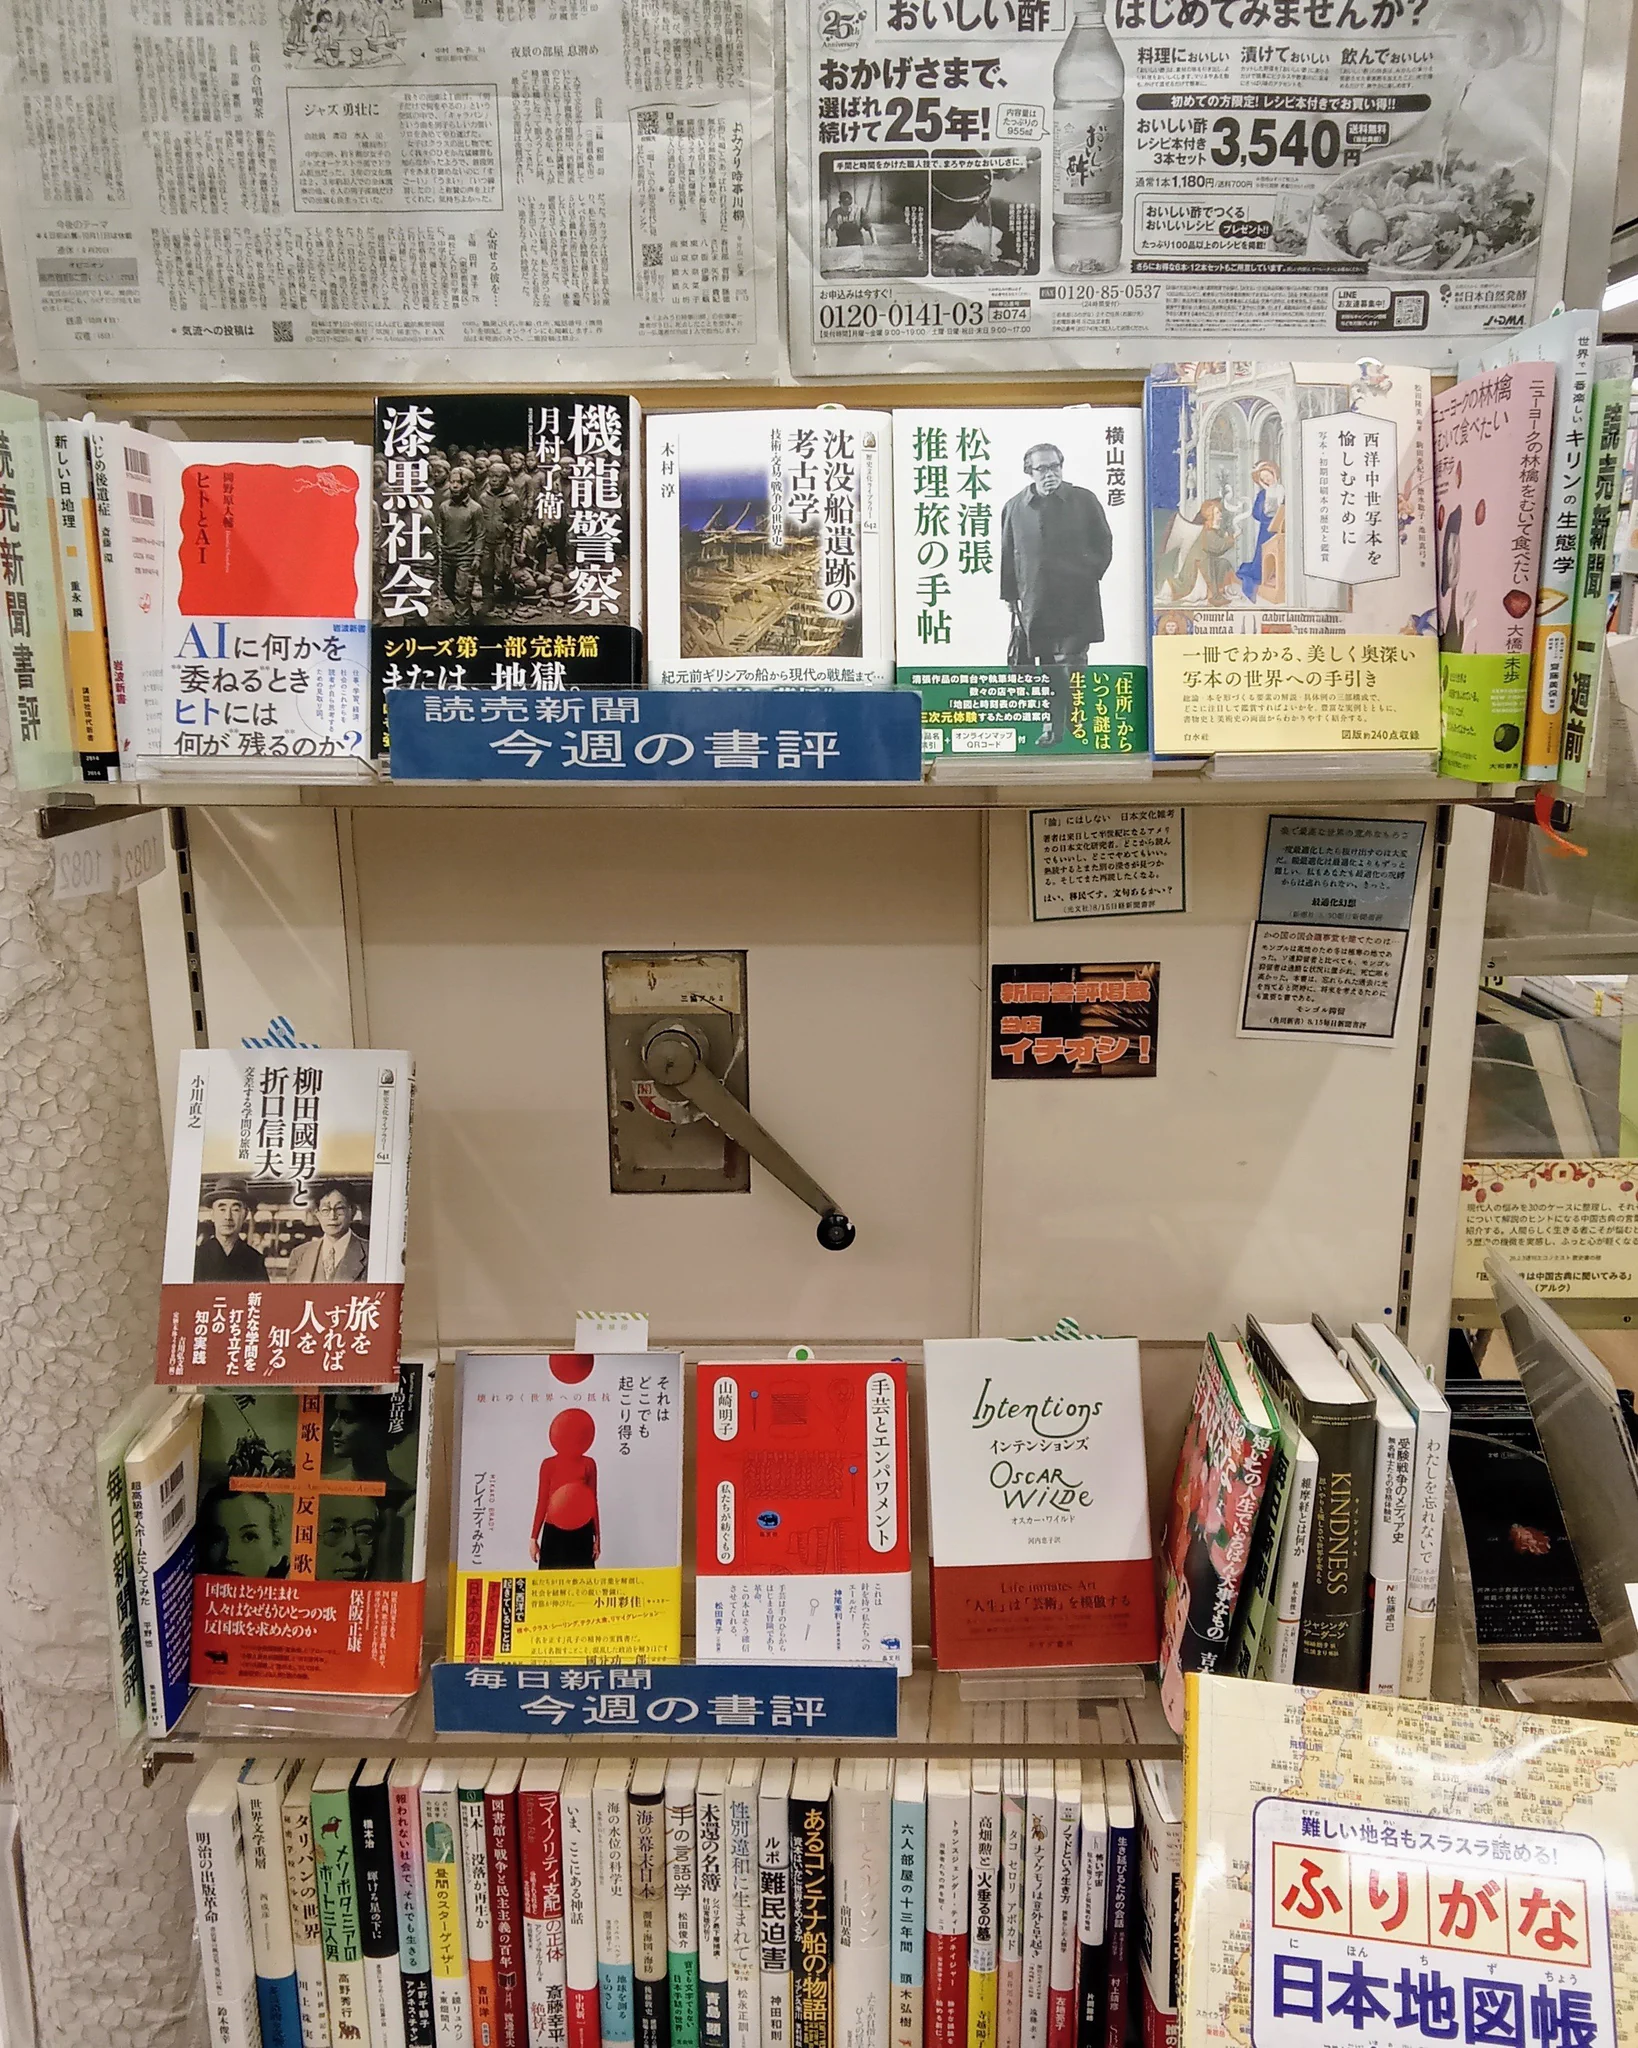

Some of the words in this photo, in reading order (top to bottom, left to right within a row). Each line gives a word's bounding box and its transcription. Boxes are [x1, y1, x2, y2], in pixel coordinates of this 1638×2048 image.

[887, 0, 1050, 33] おいしい酢
[1115, 0, 1428, 30] はじめてみませんか？
[821, 40, 860, 50] Anniversary
[818, 57, 1008, 91] おかげさまで、
[304, 104, 339, 117] ジャズ
[342, 103, 380, 116] 勇壮に
[818, 96, 883, 119] 選ばれ
[1002, 117, 1039, 128] たっぷりの
[1005, 108, 1037, 119] 内容量は
[1136, 118, 1208, 134] おいしい酢
[818, 121, 882, 144] 続けて
[1136, 138, 1207, 151] レシピ本付き
[731, 122, 745, 222] よみうり時事川柳
[1146, 205, 1246, 219] おいしい酢でつくる
[1146, 220, 1215, 232] おいしいレシピ
[819, 288, 894, 300] お申込みは今すぐ！
[1057, 284, 1162, 300] 0120-85-0537
[1338, 291, 1357, 299] LINE
[1464, 290, 1528, 302] 日本自然発酵
[182, 325, 255, 336] 気流への投稿は
[819, 302, 984, 329] 0120-0141-03
[992, 309, 1027, 321] お074
[535, 407, 566, 521] 月村了衛
[787, 428, 821, 525] 考古学
[1105, 426, 1127, 507] 横山茂彦
[1510, 379, 1546, 585] ニューヨークの林檎をむいて食べたい
[770, 427, 783, 548] 技術・交易・戦争の世界史
[956, 427, 993, 576] 松本清張
[1317, 431, 1330, 563] 写本・初期印刷本の歴史と鑑賞
[1337, 430, 1357, 546] 愉しむために
[1363, 431, 1384, 566] 西洋中世写本を
[196, 472, 211, 565] ヒトとAI
[381, 404, 437, 618] 漆黒社会
[567, 403, 623, 618] 機龍警察
[823, 428, 857, 617] 沈没船遺跡の
[912, 426, 953, 645] 推理旅の手帖
[174, 622, 347, 662] AIに何かを
[332, 623, 367, 633] 岩波新書
[383, 634, 601, 660] シリーズ第一部完結篇
[1182, 644, 1417, 665] 一冊でわかる、美しく奥深い
[113, 659, 127, 705] 岩波新書
[180, 665, 312, 695] 委ねるとき
[381, 661, 581, 693] または、地獄。
[661, 667, 885, 685] 紀元前ギリシアの船から現代の戦艦まで…
[969, 685, 1056, 698] 数々の店や宿、風景。
[1182, 669, 1378, 689] 写本の世界への手引き
[175, 698, 278, 726] ヒトには
[422, 695, 640, 724] 読売新聞
[946, 698, 1052, 710] 「地図と時刻表の作家」を
[1069, 671, 1089, 746] 生まれる。
[1092, 671, 1112, 750] いつも謎は
[1114, 670, 1134, 753] 「住所」から
[173, 730, 363, 757] 何が残るのか？
[489, 728, 841, 770] 今週の書評
[955, 732, 1014, 741] オンラインマップ
[966, 740, 1002, 750] QRコード
[1183, 733, 1209, 742] 白水社
[1341, 729, 1420, 741] 図版約240点収録
[1311, 897, 1358, 908] 最適化幻想
[1000, 981, 1151, 1004] 新聞書評掲載
[1296, 1005, 1346, 1016] モンゴル抑留
[1000, 1015, 1043, 1035] 当店
[1000, 1035, 1151, 1065] イチオシ！
[187, 1073, 205, 1129] 小川直之
[254, 1066, 290, 1179] 折口信夫
[288, 1066, 324, 1207] 柳田國男と
[1534, 1284, 1571, 1293] （アルク）
[211, 1297, 228, 1335] 二人の
[243, 1291, 263, 1372] 新たな学問を
[291, 1300, 326, 1355] 人を
[191, 1310, 210, 1365] 知の実践
[225, 1308, 245, 1376] 打ち立てた
[476, 1392, 612, 1404] 壊れゆく世界への抵抗
[618, 1375, 634, 1456] 起こり得る
[638, 1375, 651, 1439] どこでも
[657, 1376, 671, 1422] それは
[972, 1378, 1104, 1438] Intentions
[870, 1377, 891, 1547] 手芸とエンパワメント
[989, 1438, 1091, 1454] インテンションズ
[1391, 1438, 1411, 1544] 受験戦争のメディア史
[1419, 1439, 1441, 1565] わたしを忘れないで
[471, 1472, 488, 1566] ブレイディみかこ
[720, 1483, 732, 1561] 私たちが紡ぐもの
[1011, 1514, 1076, 1525] オスカー・ワイルド
[1326, 1472, 1352, 1595] KINDNESS
[1027, 1536, 1062, 1545] 河内恵子訳
[205, 1582, 300, 1601] 国歌はどう生まれ
[515, 1577, 526, 1622] 今、西洋で
[593, 1596, 642, 1609] 小川彩佳
[874, 1583, 883, 1607] これは
[1001, 1582, 1025, 1594] Life
[1078, 1580, 1097, 1591] Art
[204, 1619, 318, 1639] 反国歌を求めたのか
[205, 1601, 337, 1623] 人々はなぜもうひとつの歌
[347, 1588, 364, 1653] 保阪正康
[501, 1577, 513, 1653] 起きていることは
[741, 1584, 751, 1652] この本はそう確信
[778, 1584, 787, 1652] 手芸は手のひらから
[861, 1582, 871, 1651] 針を持つ私たちへの
[1385, 1595, 1396, 1632] 佐藤卓己
[1303, 1629, 1345, 1639] アーダーン
[464, 1667, 653, 1690] 毎日新聞
[519, 1695, 828, 1727] 今週の書評
[363, 1818, 375, 1849] 橋本治
[606, 1801, 623, 1897] 海の水位の科学史
[636, 1810, 656, 1899] 海の幕末日本
[670, 1803, 695, 1901] 手の言語学
[765, 1837, 780, 1864] ルポ
[1009, 1829, 1019, 1852] タコ
[1300, 1815, 1558, 1866] 難しい地名もスラスラ読める！
[195, 1831, 219, 1923] 明治の出版革命
[296, 1814, 320, 1939] タリバンの世界
[396, 1793, 418, 1967] 報われない社会で、それでも生きる
[491, 1799, 513, 1968] 図書館と戦争と民主主義の百年
[567, 1805, 584, 1926] いま、ここにある神話
[729, 1800, 753, 1962] 性別違和に生まれて
[1007, 1860, 1019, 1894] セロリ
[1060, 1823, 1073, 1904] ノマドという生き方
[1094, 1853, 1105, 1888] 怖い宇宙
[1113, 1836, 1129, 1929] 生き延びるための会話
[900, 1823, 915, 1953] 六人部屋の十三年間
[1280, 1857, 1581, 1952] ふりがな
[434, 1868, 454, 1975] 昼間のスターゲイザー
[677, 1911, 689, 1949] 松田俊介
[761, 1871, 787, 1971] 難民迫害
[801, 1807, 828, 2020] あるコンテナ船の物語
[1007, 1902, 1018, 1951] アボカド
[1289, 1938, 1300, 1950] に
[338, 1973, 352, 2018] 高野秀行
[405, 1980, 418, 2042] アグネス・チャン
[417, 1980, 430, 2029] 上野千鶴子
[477, 1985, 490, 2017] 吉川洋
[604, 1974, 613, 2010] ものさし
[616, 1975, 628, 2019] 地球を測る
[737, 1989, 749, 2032] 松永正訓
[900, 1973, 913, 2027] 頭木弘樹
[1272, 1953, 1598, 2048] 日本地図帳
[440, 1996, 450, 2032] 東畑開人
[451, 1996, 463, 2042] 鏡リュウジ
[769, 1995, 783, 2042] 神田和則
